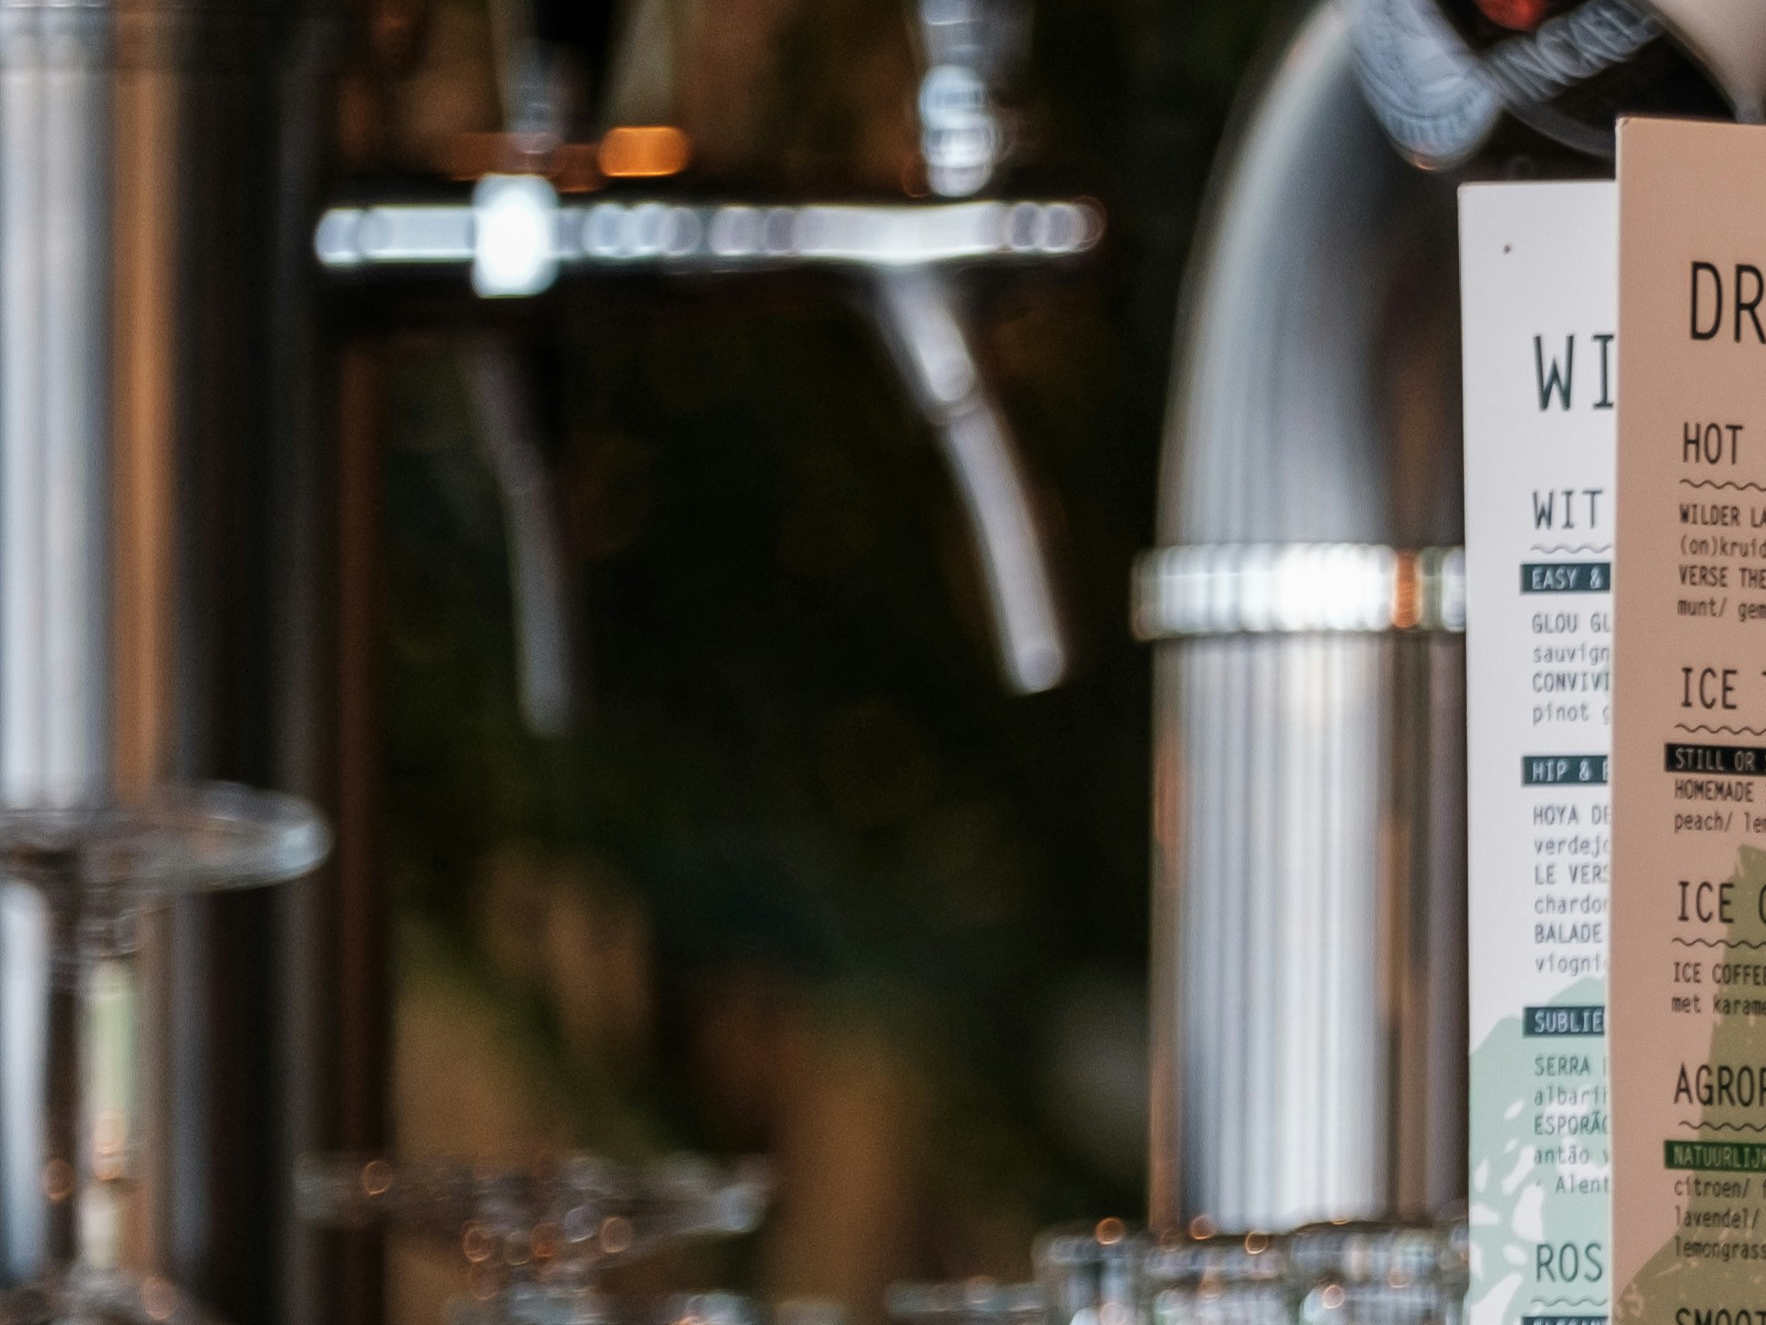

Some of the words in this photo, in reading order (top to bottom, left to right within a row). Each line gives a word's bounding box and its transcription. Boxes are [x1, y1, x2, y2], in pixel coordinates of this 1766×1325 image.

[1534, 333, 1615, 410] WI
[1683, 422, 1744, 464] HOT
[1532, 489, 1603, 529] WIT
[1679, 503, 1740, 526] WILDER
[1531, 566, 1579, 590] EASY
[1678, 564, 1728, 587] VERSE
[1677, 598, 1727, 616] munt/
[1531, 612, 1579, 634] GLOU
[1681, 666, 1738, 710] ICE
[1532, 702, 1590, 725] pinot
[1532, 759, 1569, 782] HIP
[1674, 747, 1725, 772] STILL
[1673, 779, 1753, 803] HOMEMADE
[1533, 805, 1579, 824] HOYA
[1674, 811, 1733, 832] peach/
[1678, 880, 1735, 924] ICE
[1534, 923, 1601, 943] BALADE
[1674, 961, 1702, 983] ICE
[1534, 1055, 1590, 1077] SERRA
[1534, 1144, 1591, 1165] antão
[1674, 1176, 1751, 1198] citroen/
[1674, 1205, 1759, 1229] lavendel/
[1536, 1242, 1603, 1282] ROS
